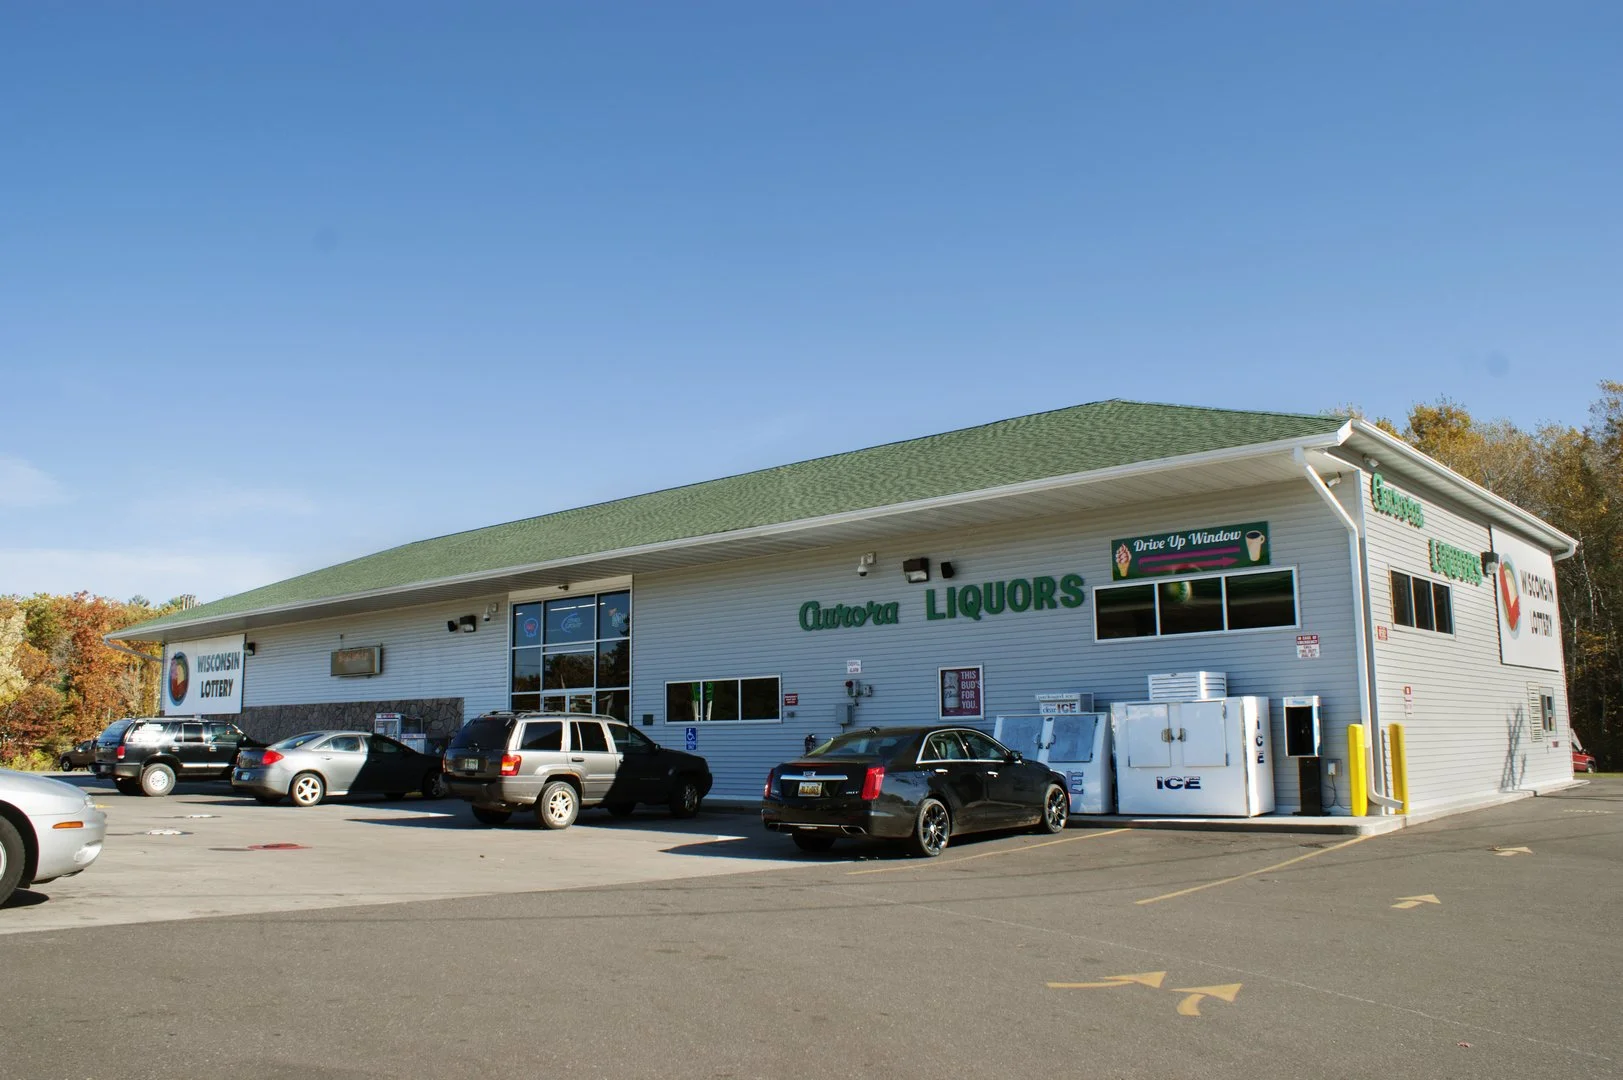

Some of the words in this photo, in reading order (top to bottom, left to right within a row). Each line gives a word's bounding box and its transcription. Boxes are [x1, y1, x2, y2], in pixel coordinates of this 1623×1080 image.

[1134, 539, 1165, 552] Drive
[1168, 535, 1185, 550] Up
[1188, 530, 1241, 545] Window
[1428, 538, 1482, 586] LIQUORS
[1520, 569, 1554, 603] WISCONSIN
[799, 601, 899, 631] Aurora
[926, 574, 1085, 621] LIQUORS
[1530, 609, 1553, 637] LOTTERY
[197, 651, 240, 673] WISCONSIN
[961, 670, 977, 680] THIS
[200, 679, 233, 698] LOTTERY
[961, 680, 980, 690] BUD'S
[961, 690, 975, 699] FOR
[961, 700, 978, 709] YOU.
[1057, 702, 1077, 713] ICE
[1156, 776, 1201, 789] ICE
